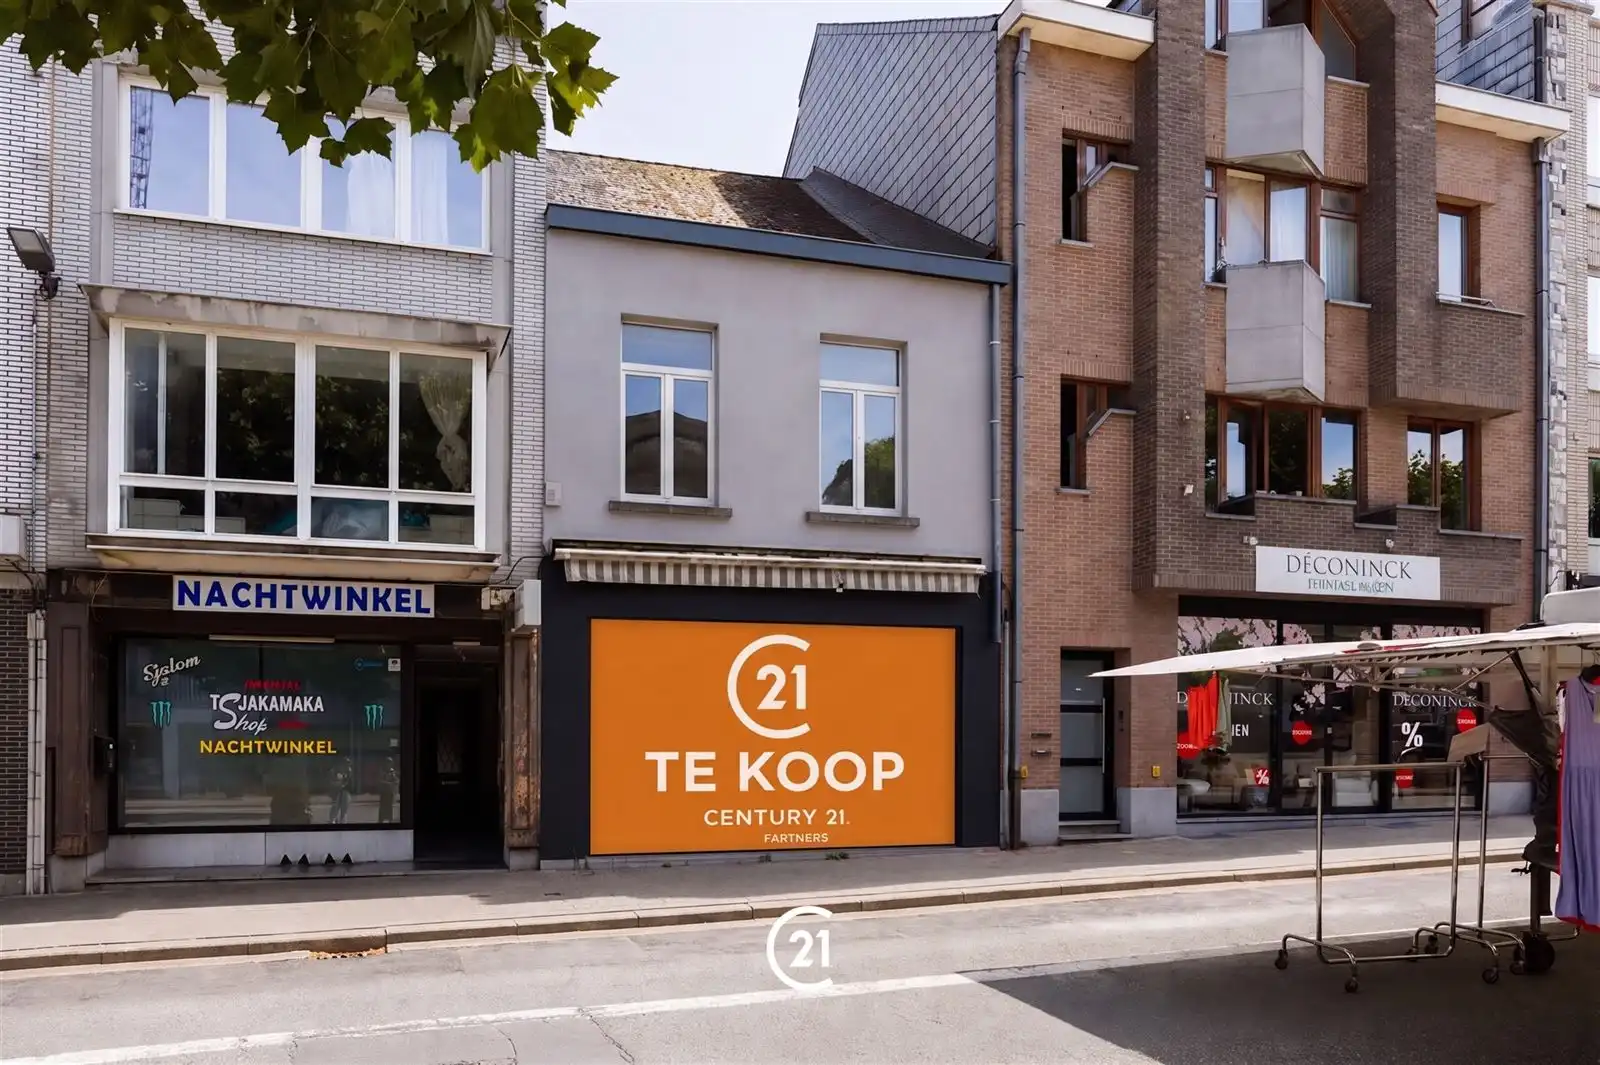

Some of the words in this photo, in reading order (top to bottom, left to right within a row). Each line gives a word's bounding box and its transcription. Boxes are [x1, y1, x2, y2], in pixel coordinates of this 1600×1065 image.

[1286, 552, 1412, 579] DÉCONINCK
[177, 580, 430, 614] NACHTWINKEL
[200, 740, 337, 754] NACHTWINKEL
[645, 751, 716, 792] TE
[739, 751, 904, 792] KOOP
[703, 808, 817, 826] CENTURY
